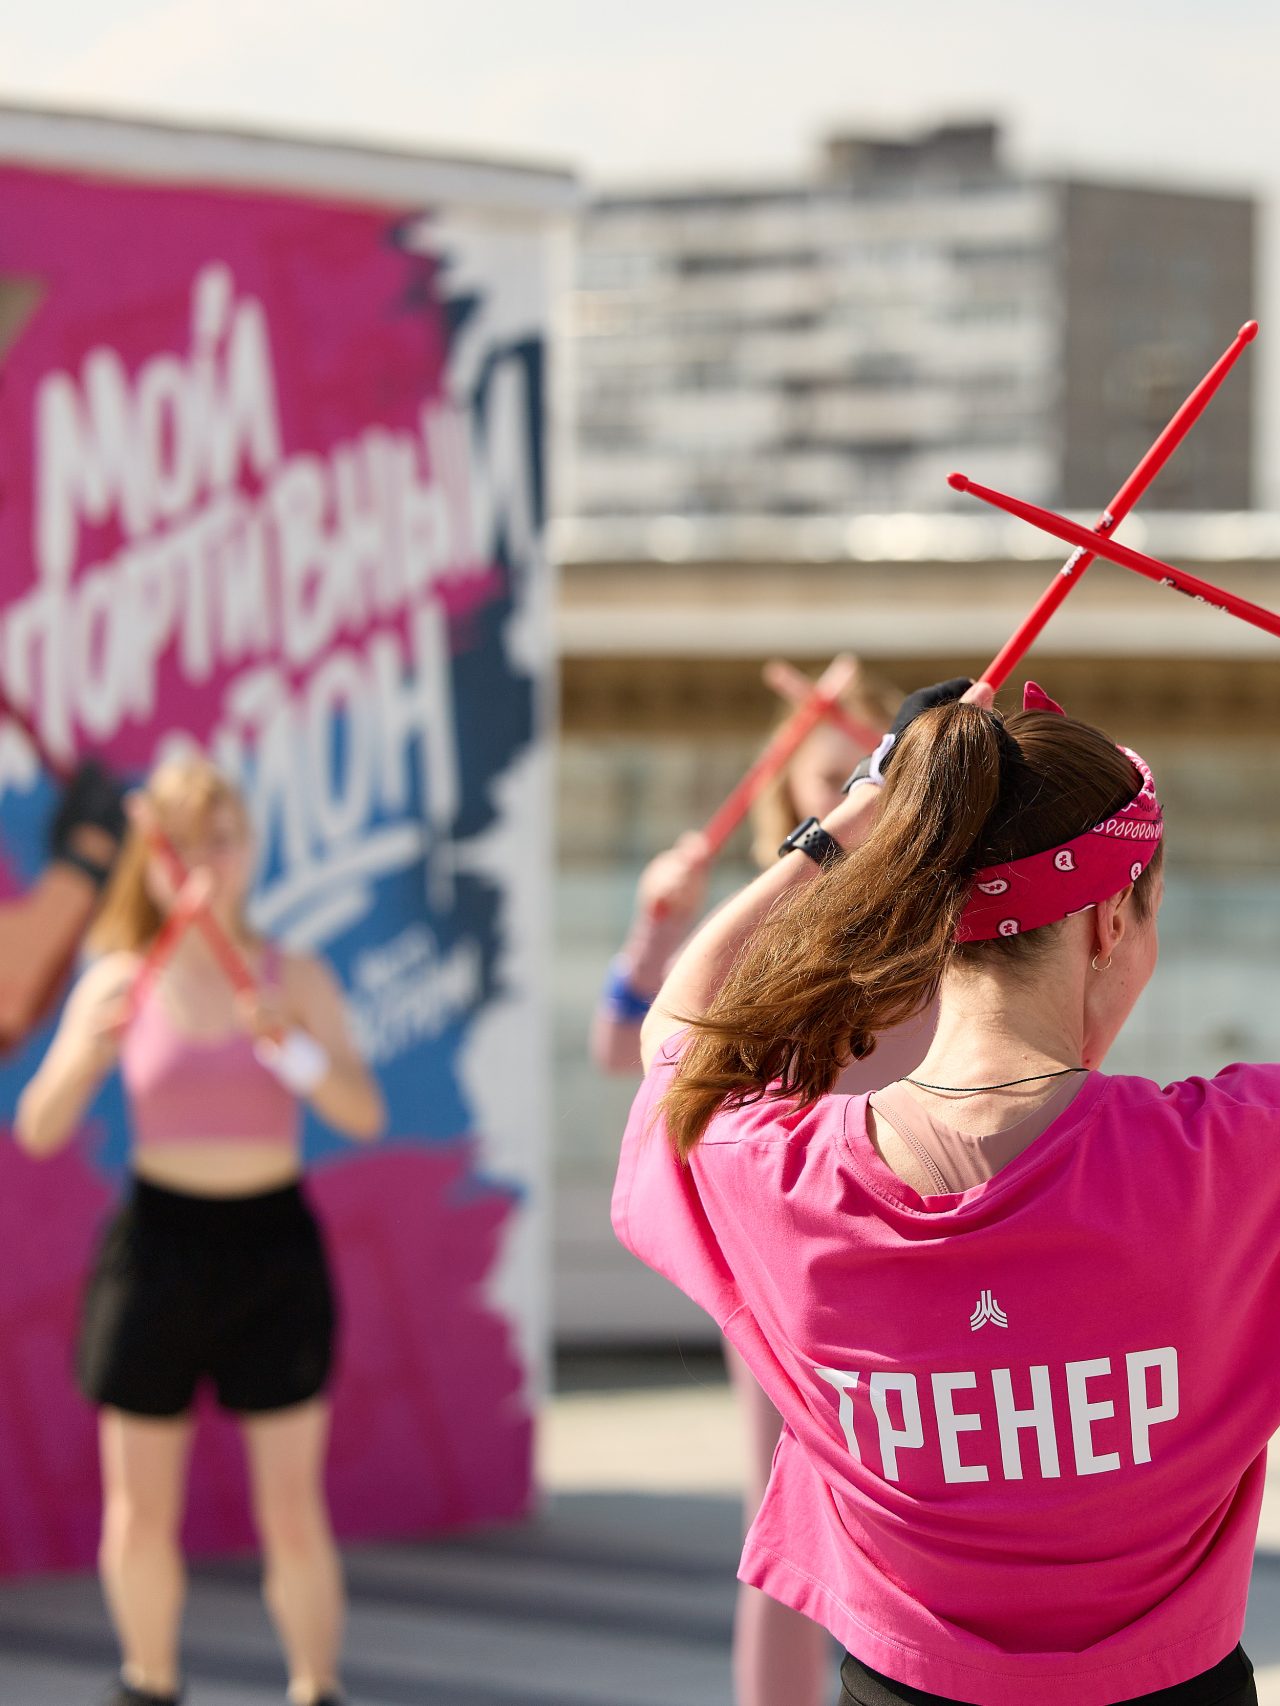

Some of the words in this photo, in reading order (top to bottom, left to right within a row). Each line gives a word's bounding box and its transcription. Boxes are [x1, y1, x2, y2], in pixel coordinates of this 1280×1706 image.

[0, 315, 545, 785] ПОРТИВНЫЙ
[36, 258, 282, 565] МОЙ
[813, 1346, 1179, 1484] ТРЕНЕР
